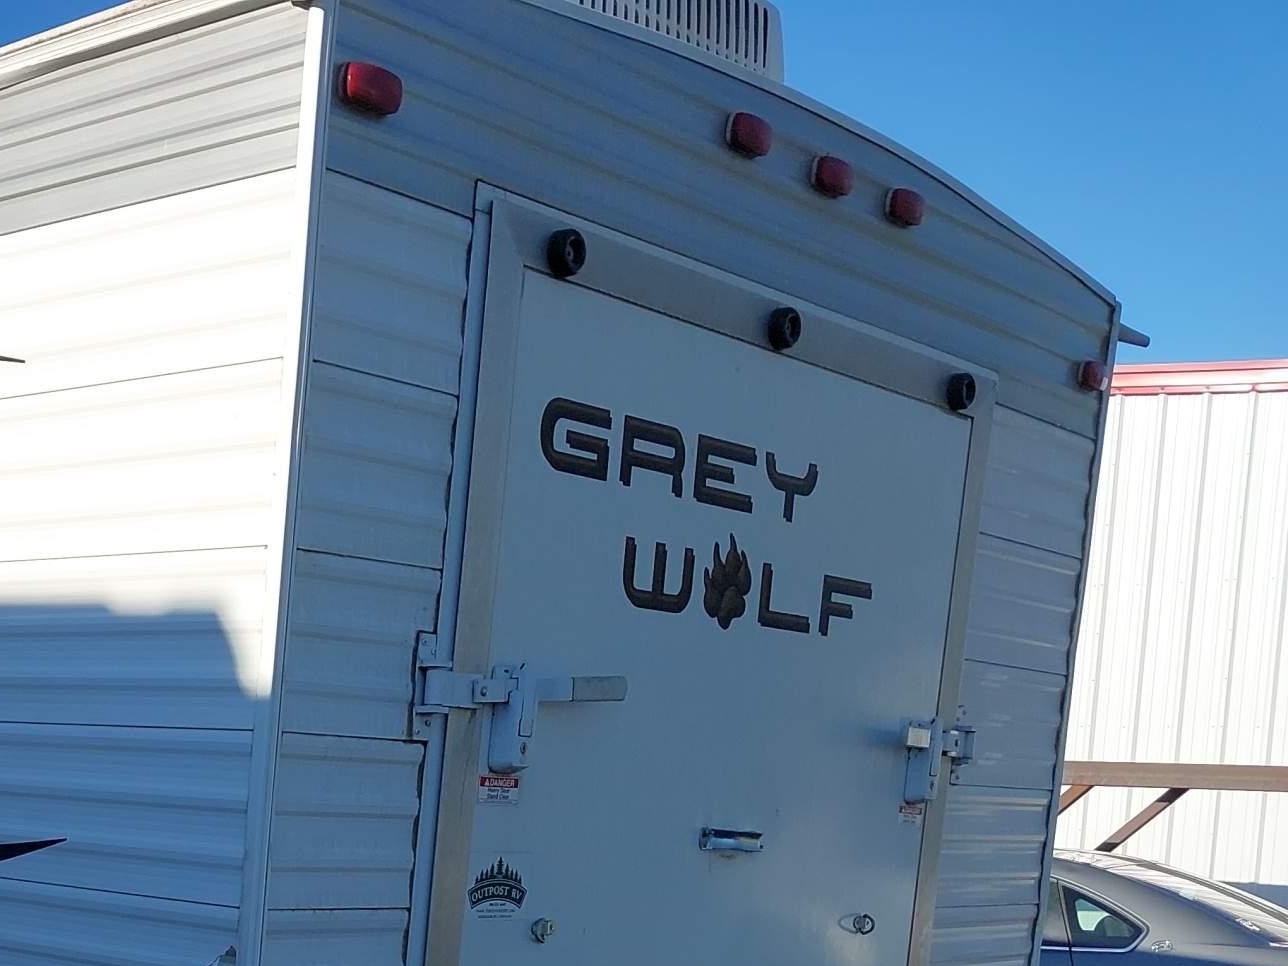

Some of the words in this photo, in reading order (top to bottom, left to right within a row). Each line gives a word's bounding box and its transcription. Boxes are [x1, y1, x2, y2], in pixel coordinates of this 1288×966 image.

[539, 396, 819, 523] GREY
[471, 885, 510, 902] OUTPOST
[511, 888, 523, 900] RV
